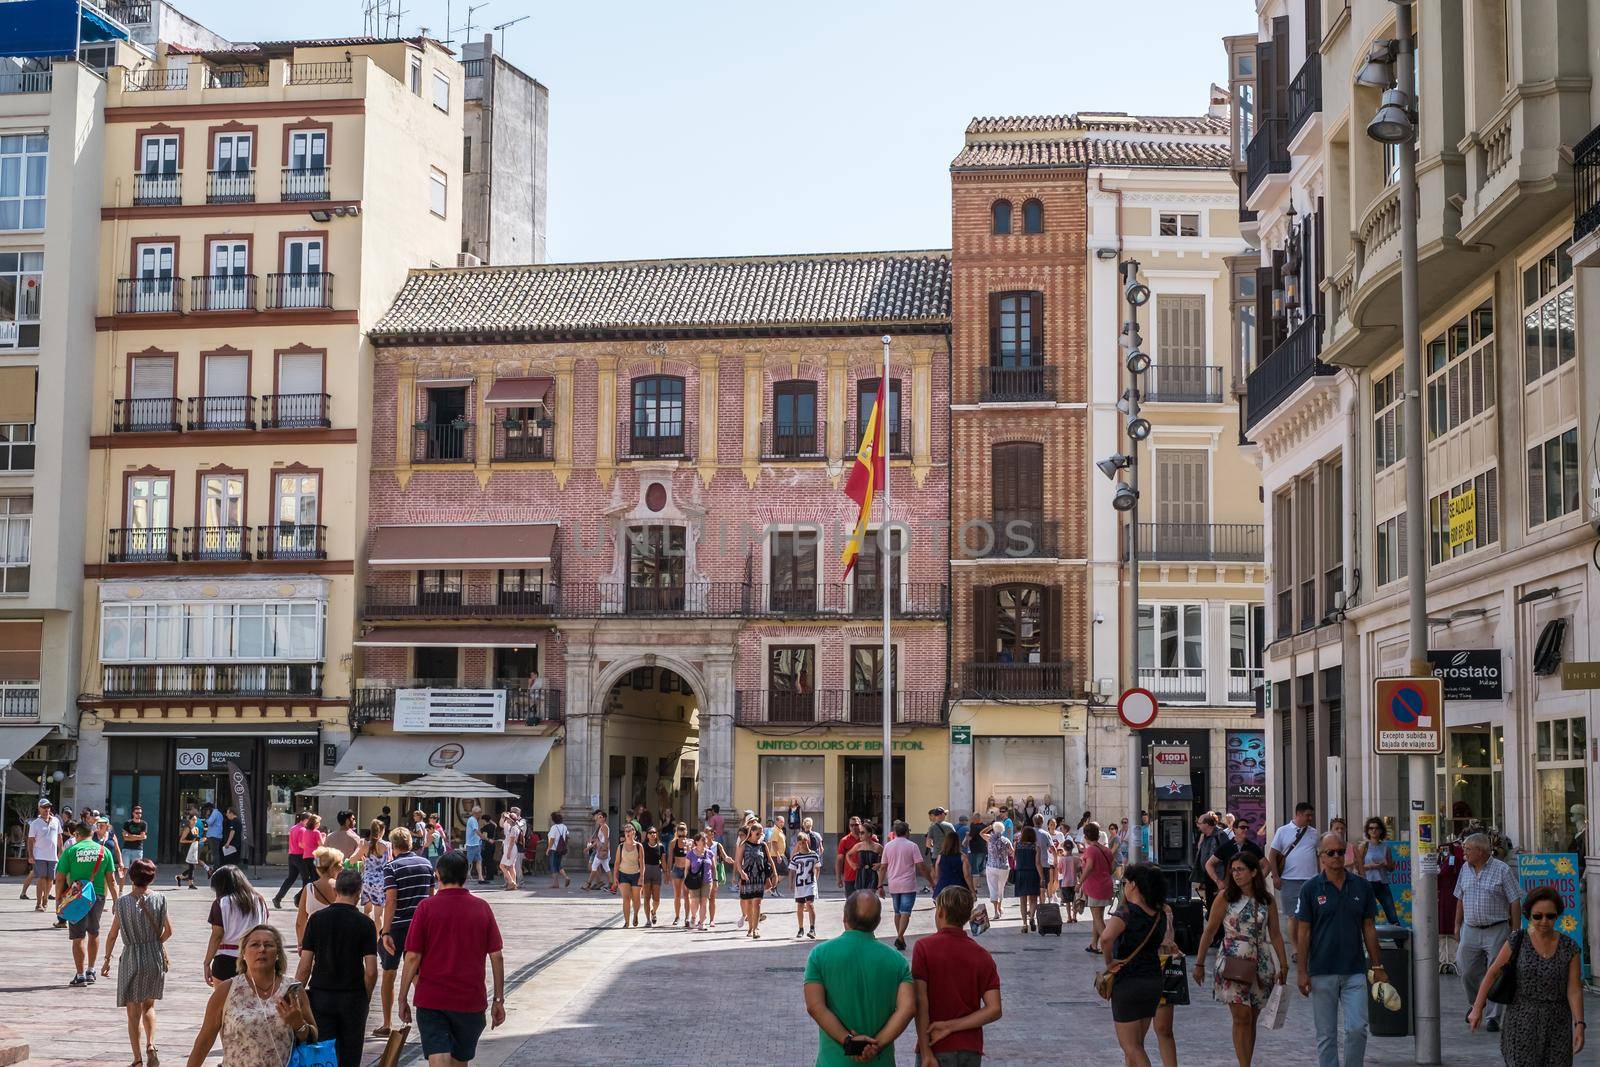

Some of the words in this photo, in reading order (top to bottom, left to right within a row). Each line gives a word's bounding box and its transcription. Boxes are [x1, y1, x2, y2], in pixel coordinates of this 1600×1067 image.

[1431, 666, 1499, 678] erostato
[1382, 732, 1405, 740] Excepto
[757, 740, 797, 750] UNITED
[800, 740, 844, 750] COLORS
[847, 740, 862, 750] OF
[1381, 740, 1400, 748] bajada
[1409, 740, 1435, 748] viajeros
[1239, 786, 1261, 794] NYX
